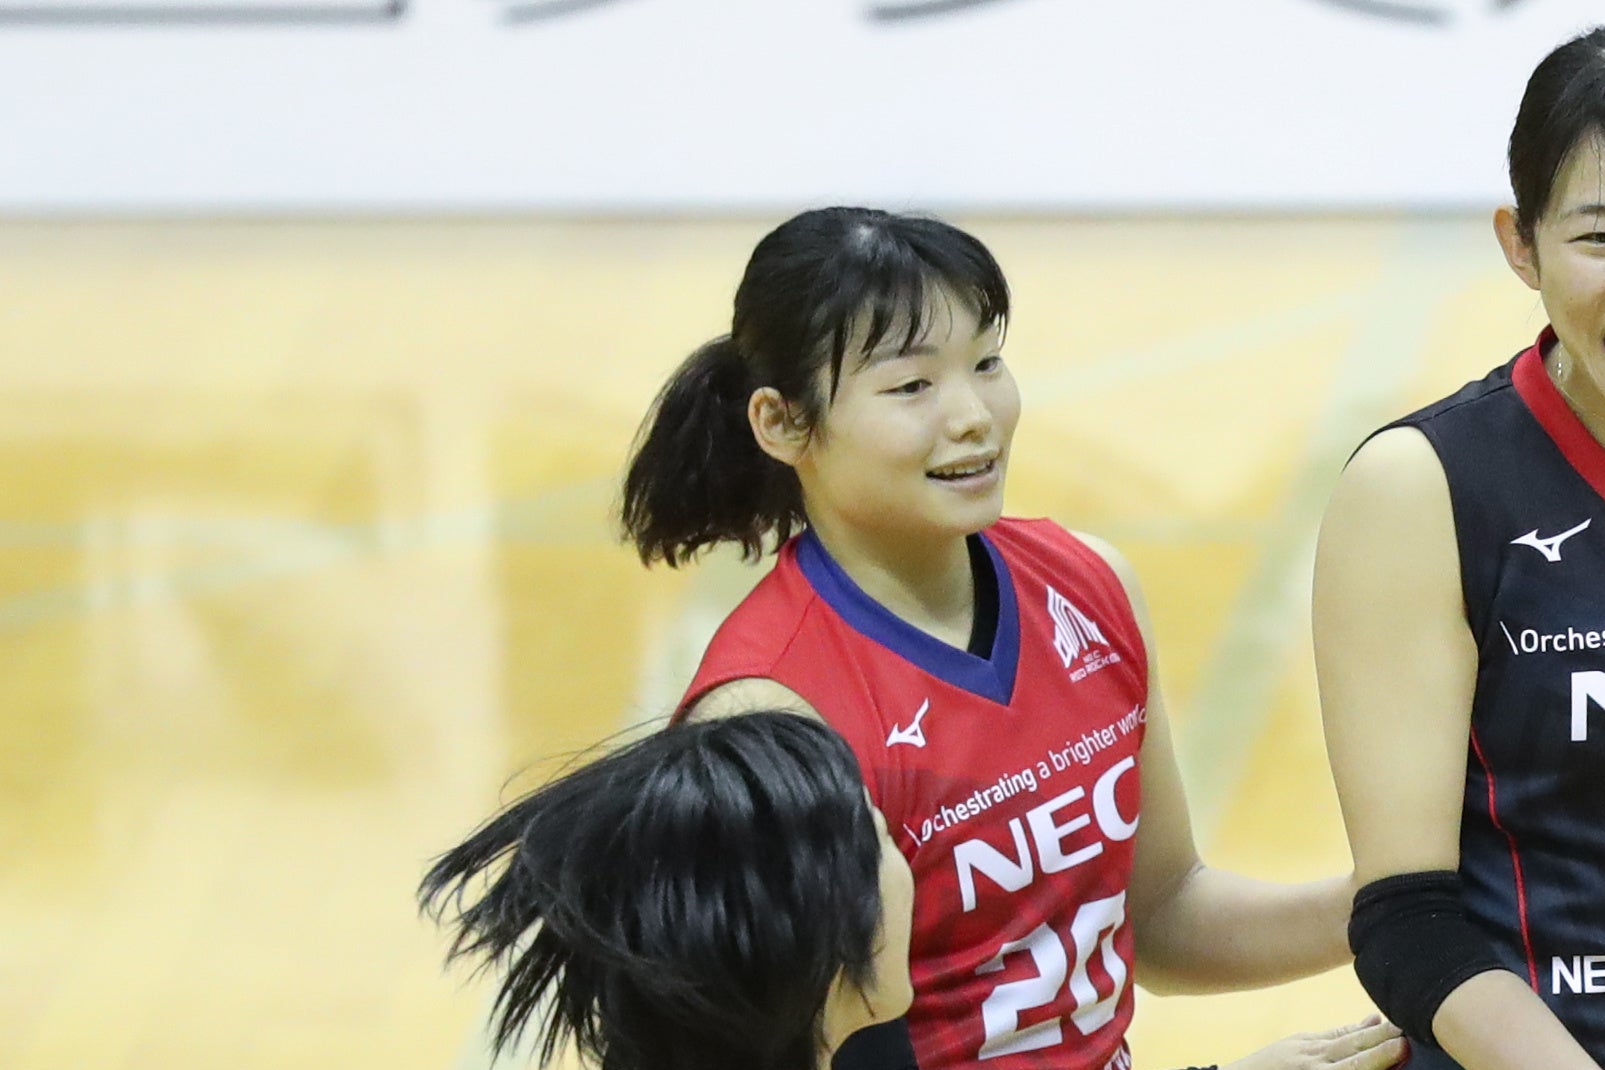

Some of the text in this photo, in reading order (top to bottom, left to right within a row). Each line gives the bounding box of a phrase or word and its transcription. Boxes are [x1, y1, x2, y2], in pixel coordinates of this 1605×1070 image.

[1037, 761, 1051, 779] a
[1048, 724, 1118, 771] brighter
[953, 756, 1140, 913] NEC
[975, 890, 1128, 1061] 20
